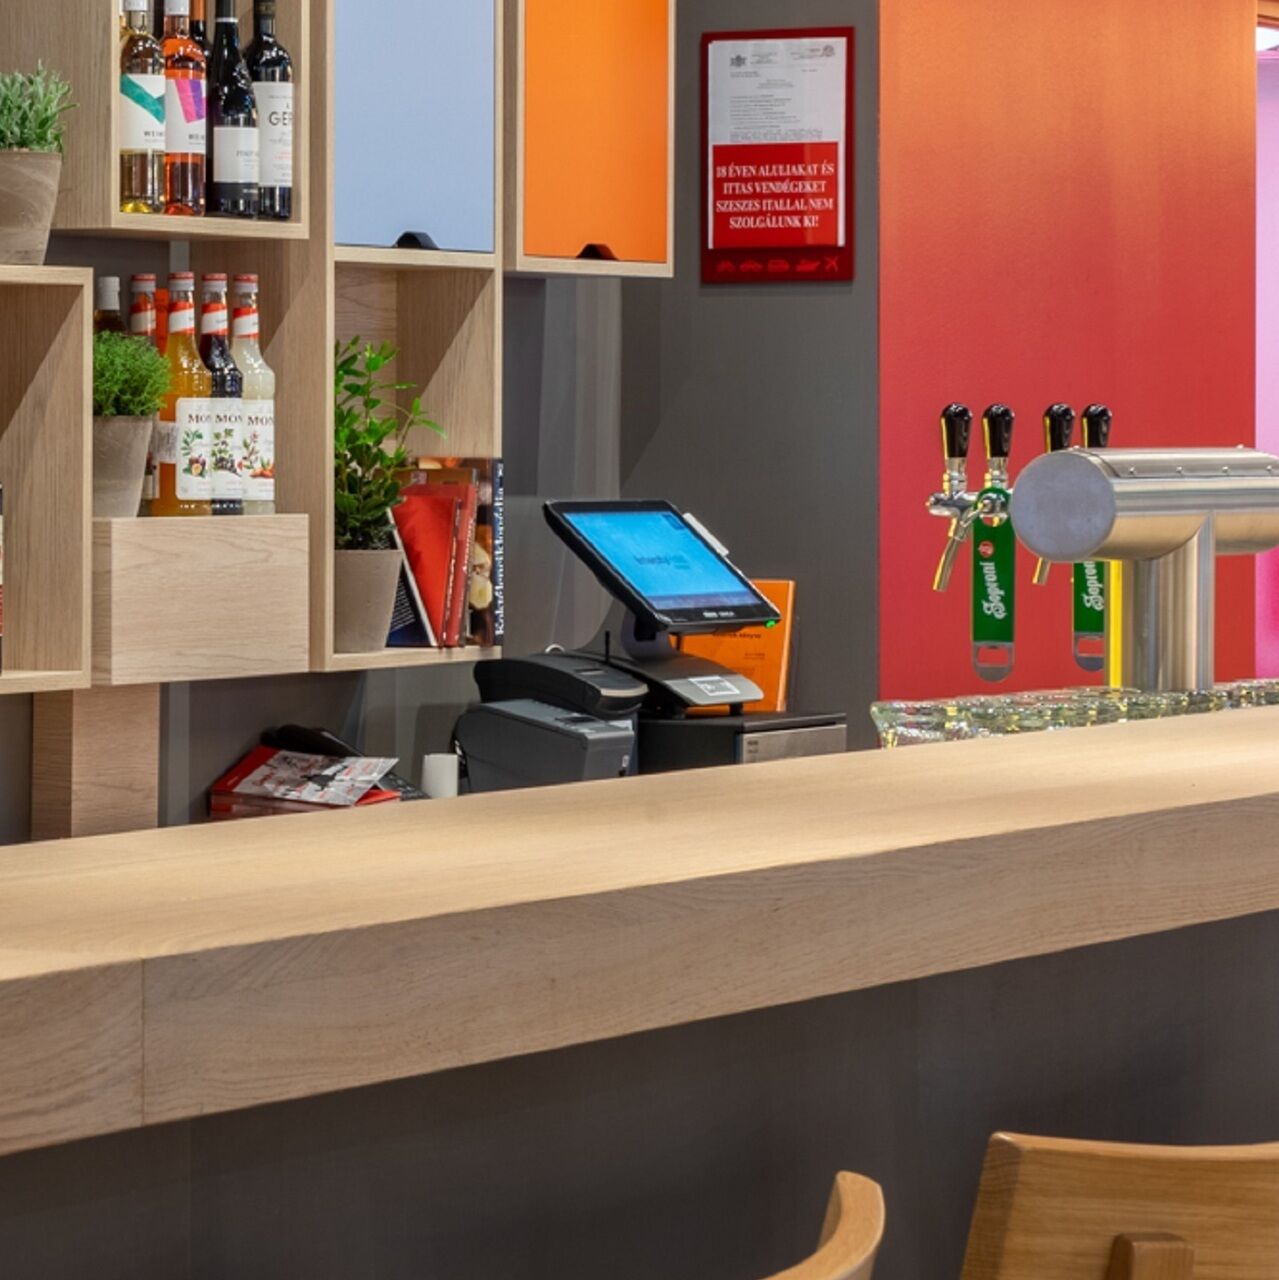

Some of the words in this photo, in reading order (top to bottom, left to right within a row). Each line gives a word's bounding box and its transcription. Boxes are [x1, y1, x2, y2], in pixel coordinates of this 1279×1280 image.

[728, 162, 757, 178] ÉVEN
[821, 160, 834, 176] ÉS
[723, 182, 754, 194] ITTAS
[755, 179, 827, 193] VENDÉGEKET
[716, 200, 760, 212] SZESZES
[762, 199, 807, 211] ITALLAL
[809, 198, 833, 210] NEM
[729, 213, 801, 229] SZOLGÁLUNK
[979, 561, 1007, 620] Soproni
